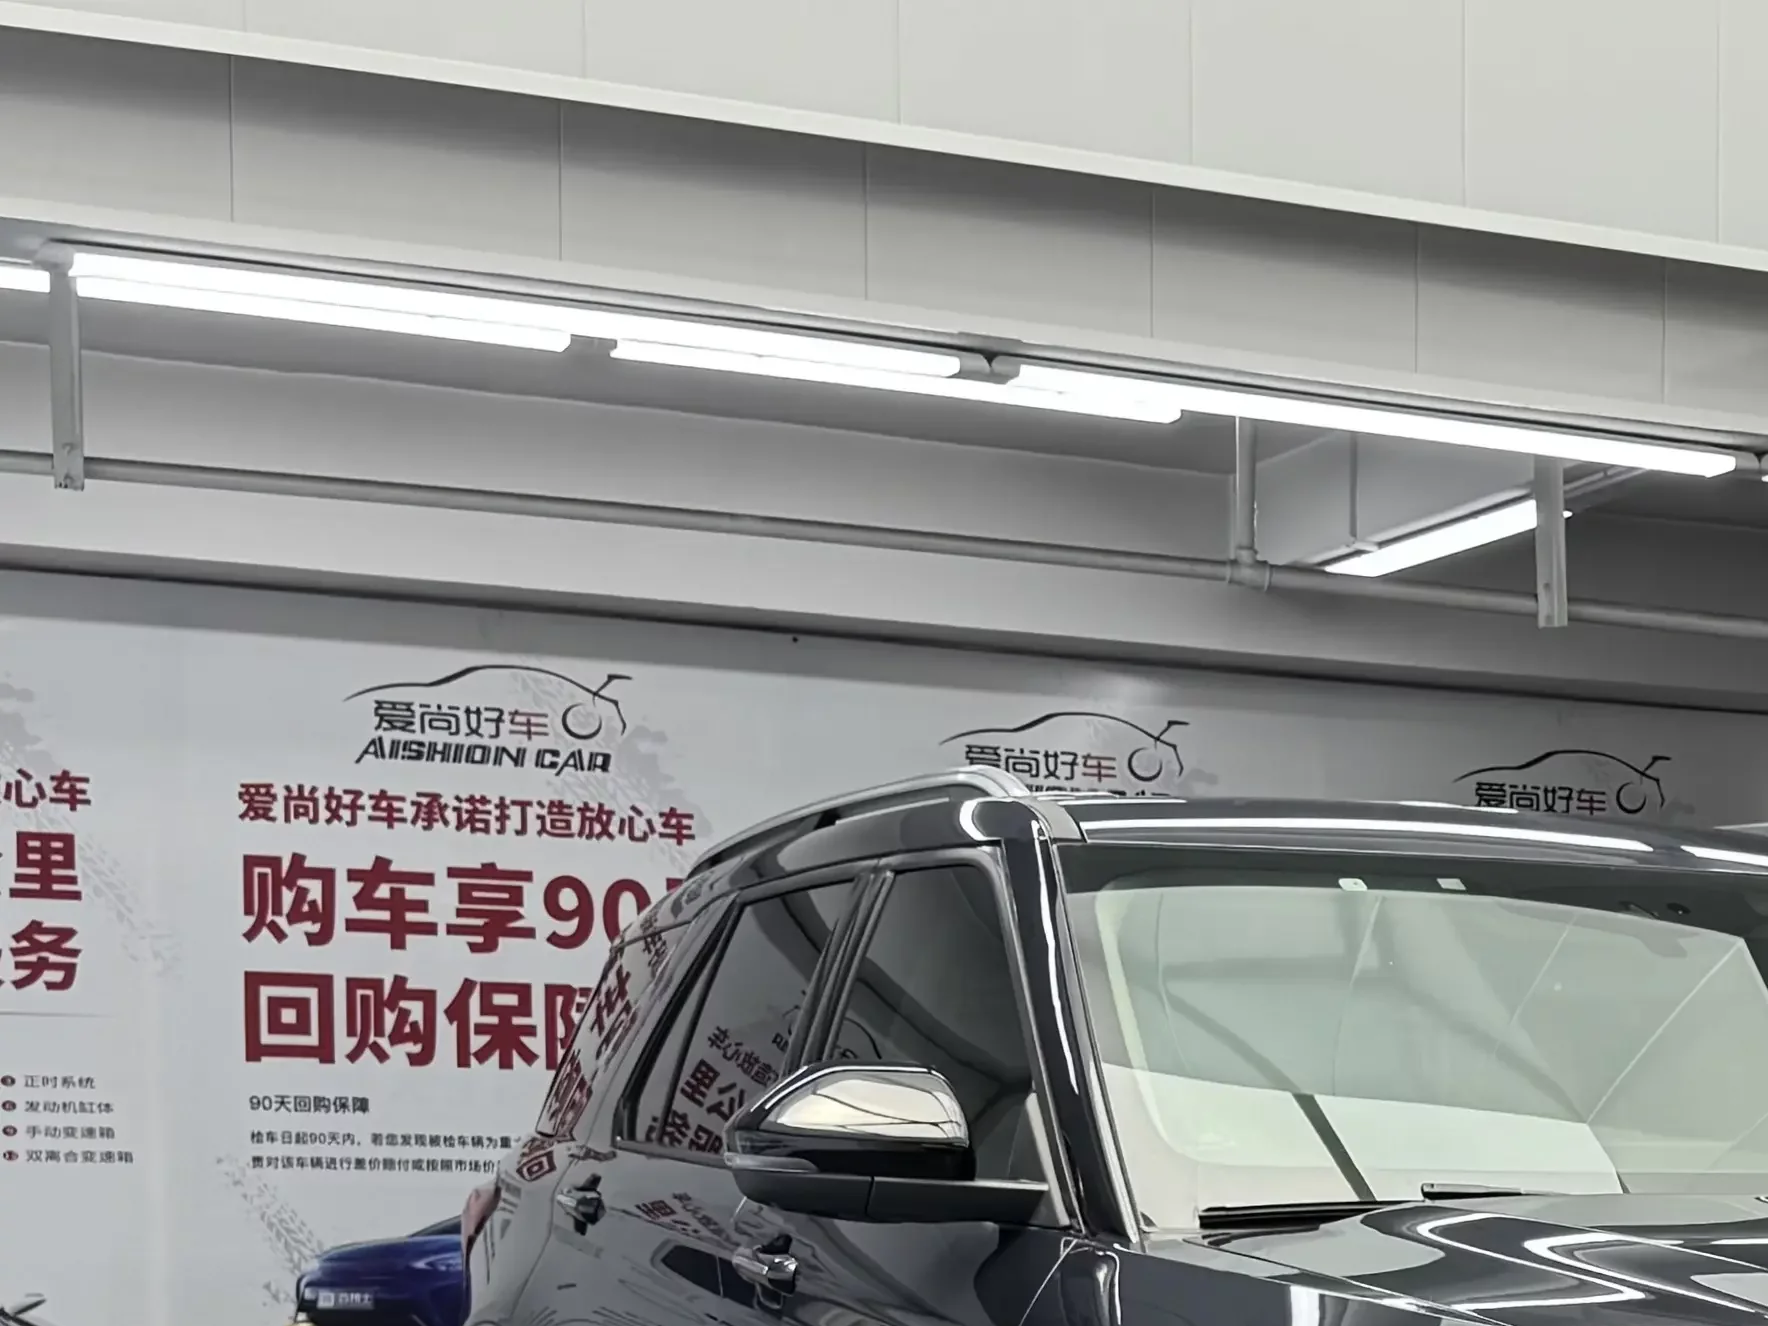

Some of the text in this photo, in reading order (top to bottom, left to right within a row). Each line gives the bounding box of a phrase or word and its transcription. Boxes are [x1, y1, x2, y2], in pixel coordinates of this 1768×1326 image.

[370, 700, 549, 741] 爱尚好车
[355, 735, 612, 776] AISHION CAR
[965, 744, 1117, 783] 爱尚好车
[0, 768, 92, 812] 心车
[1475, 781, 1608, 816] 爱尚好车
[238, 782, 696, 847] 爱尚好车承诺打造放心车
[0, 831, 82, 901] 里
[242, 853, 684, 953] 购车享90
[0, 919, 82, 991] 务
[24, 1075, 96, 1089] 正时系统
[24, 1100, 114, 1114] 发动机缸体
[249, 1095, 370, 1115] 90天回购保障
[25, 1125, 116, 1140] 手动变速箱
[251, 1130, 521, 1149] 检车日起90天内，若您发现被检车辆为重
[26, 1150, 134, 1164] 双离合变速箱
[252, 1155, 500, 1174] 责对该车辆进行差价赔付或按照市场价
